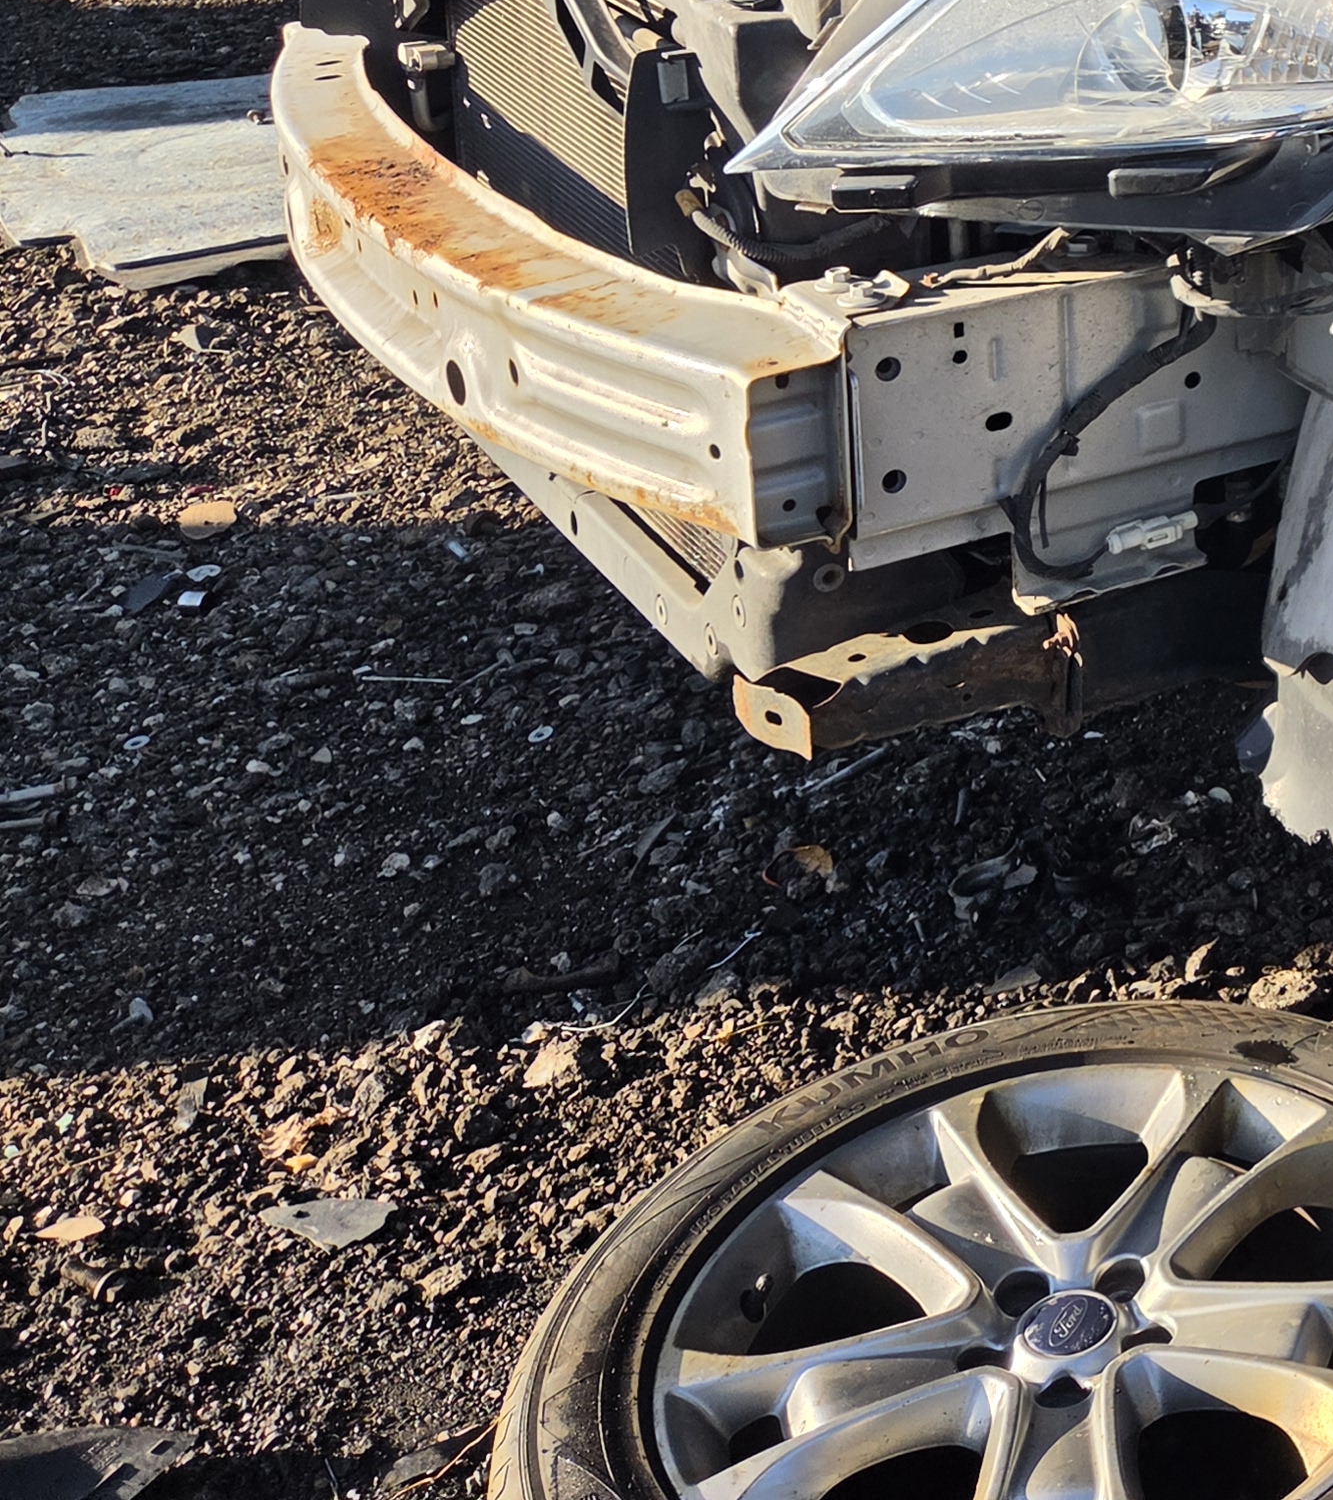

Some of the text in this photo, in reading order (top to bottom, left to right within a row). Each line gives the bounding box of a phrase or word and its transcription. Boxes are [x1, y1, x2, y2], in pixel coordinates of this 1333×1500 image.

[754, 1029, 990, 1136] KUMHO
[720, 1151, 783, 1205] RADIAL
[780, 1102, 868, 1157] TUBELESS
[1053, 1304, 1084, 1339] Ford
